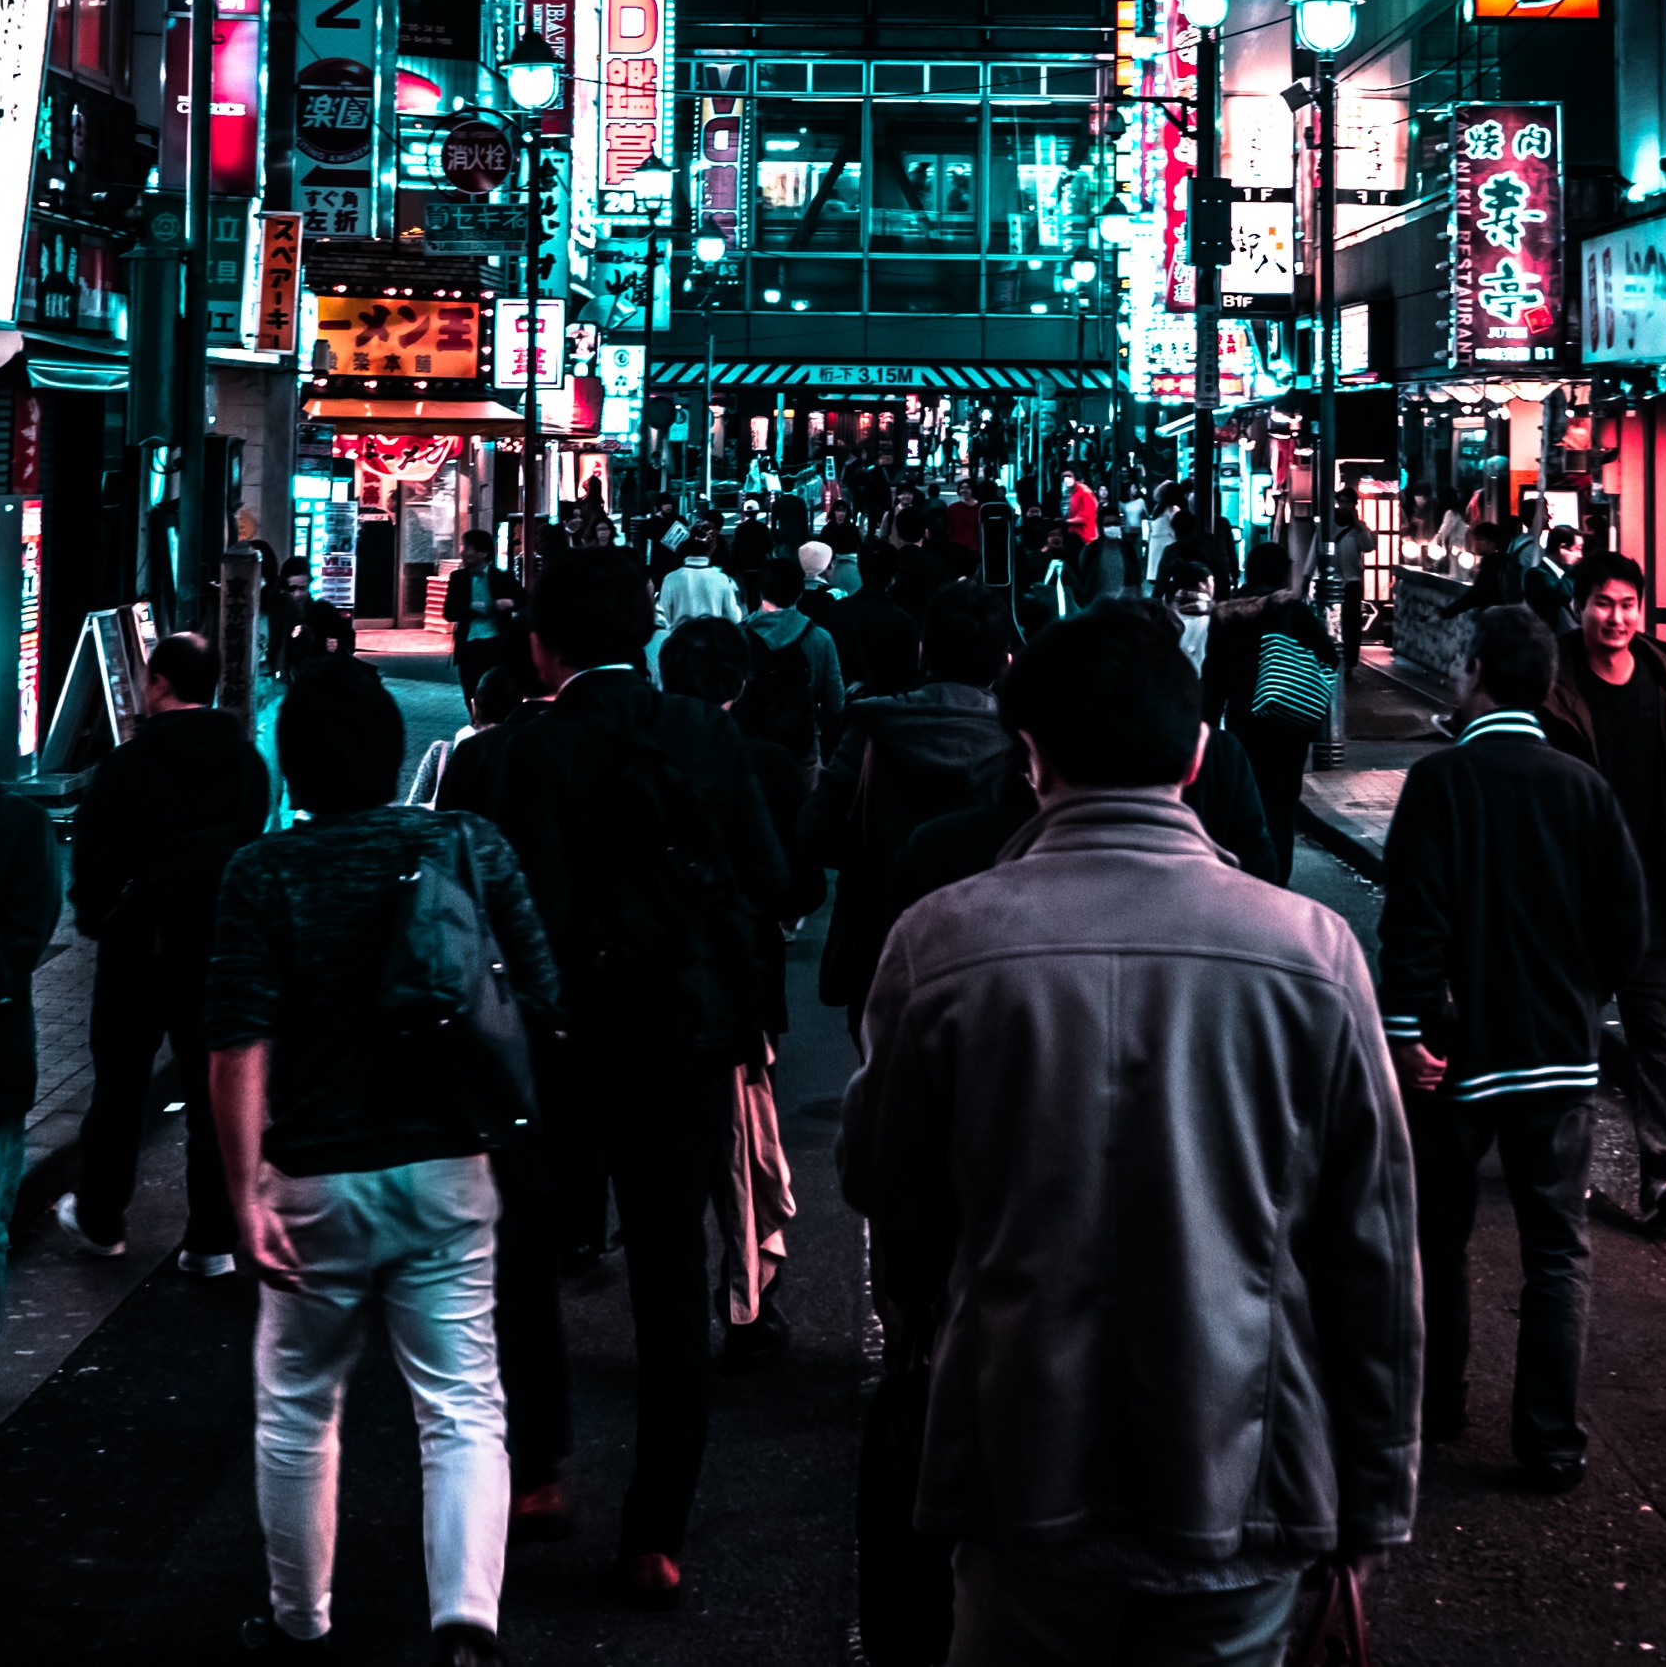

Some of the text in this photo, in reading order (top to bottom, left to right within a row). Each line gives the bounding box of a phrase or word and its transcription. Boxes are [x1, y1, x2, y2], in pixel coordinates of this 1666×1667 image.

[300, 93, 374, 131] 楽園
[1464, 119, 1552, 160] 焼肉
[446, 143, 508, 172] 消火栓
[303, 189, 359, 209] すぐ角
[303, 207, 359, 234] 左折
[264, 220, 296, 349] スペアーキー
[1456, 229, 1474, 368] RESTAURANT
[1221, 294, 1254, 309] B1F
[1534, 346, 1555, 360] B1
[819, 365, 915, 386] 桁下 3.15M
